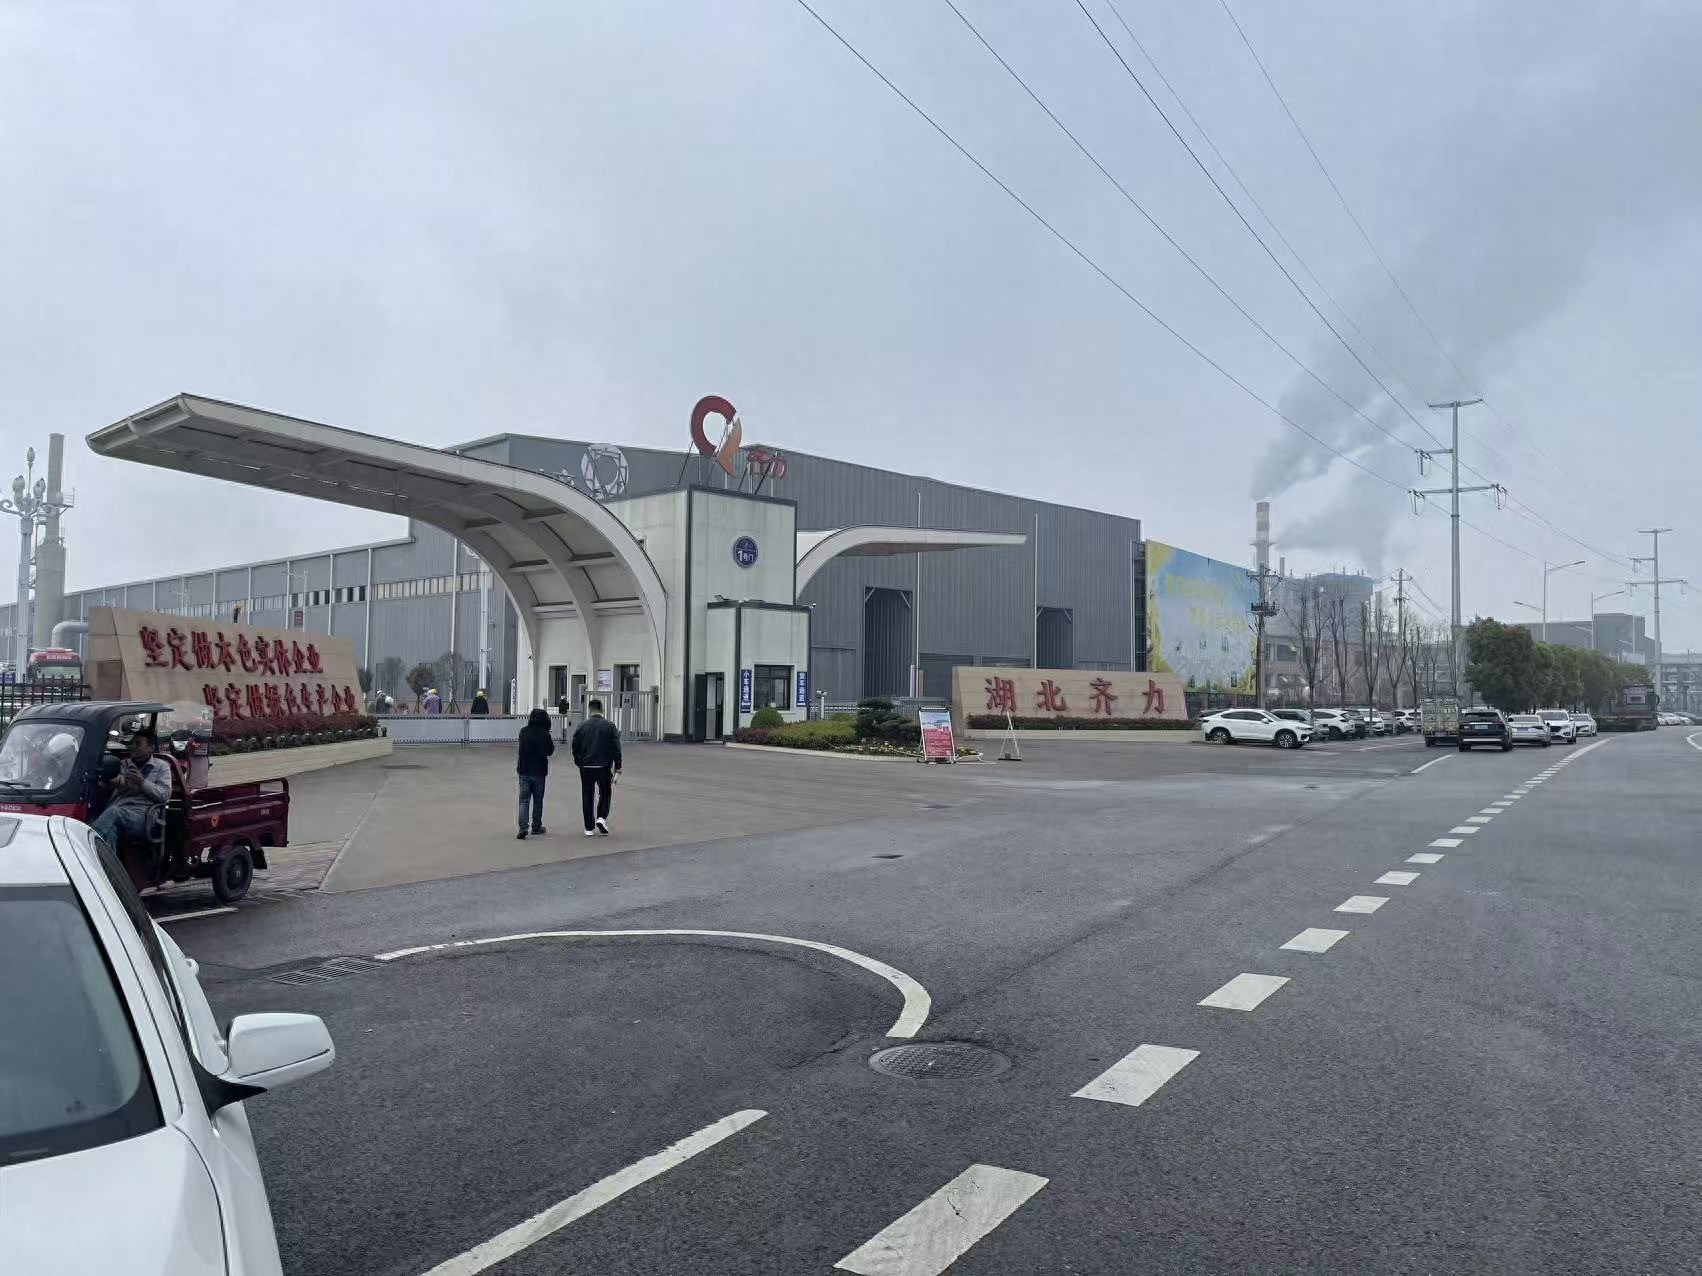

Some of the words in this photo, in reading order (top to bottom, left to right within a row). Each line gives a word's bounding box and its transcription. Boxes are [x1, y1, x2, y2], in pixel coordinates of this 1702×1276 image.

[139, 626, 324, 677] 坚定做本色实体企业
[985, 676, 1167, 716] 湖北齐力
